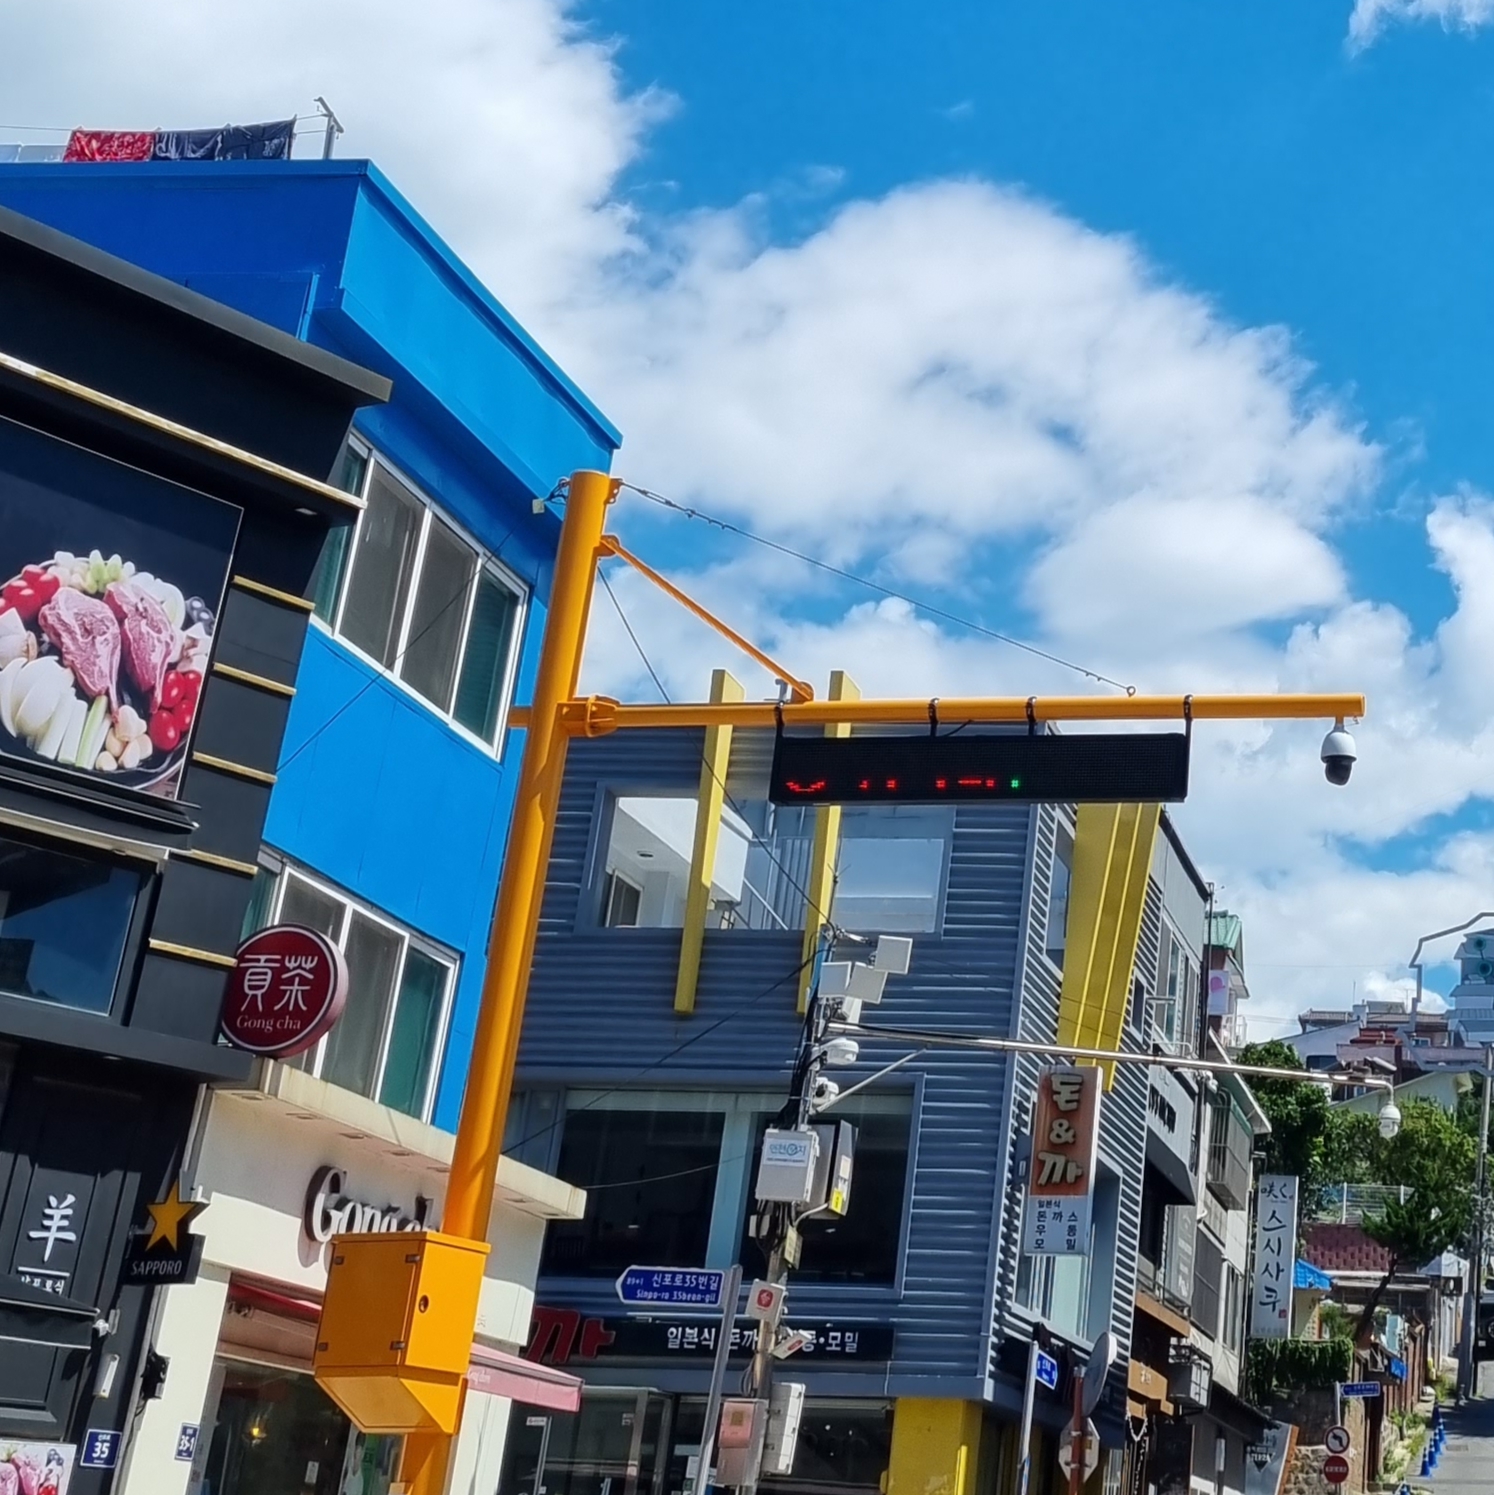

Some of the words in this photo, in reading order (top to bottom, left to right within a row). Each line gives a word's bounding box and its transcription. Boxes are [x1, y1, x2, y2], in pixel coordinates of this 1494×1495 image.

[236, 1015, 274, 1033] Gong
[276, 1015, 301, 1029] cha
[27, 1193, 76, 1263] 羊
[131, 1260, 182, 1275] SAPPORO
[652, 1273, 718, 1291] 신포로35번길
[636, 1289, 669, 1300] Sinpo-ro
[667, 1327, 715, 1350] 일본식
[729, 1328, 760, 1350] 돈까
[92, 1442, 111, 1458] 35
